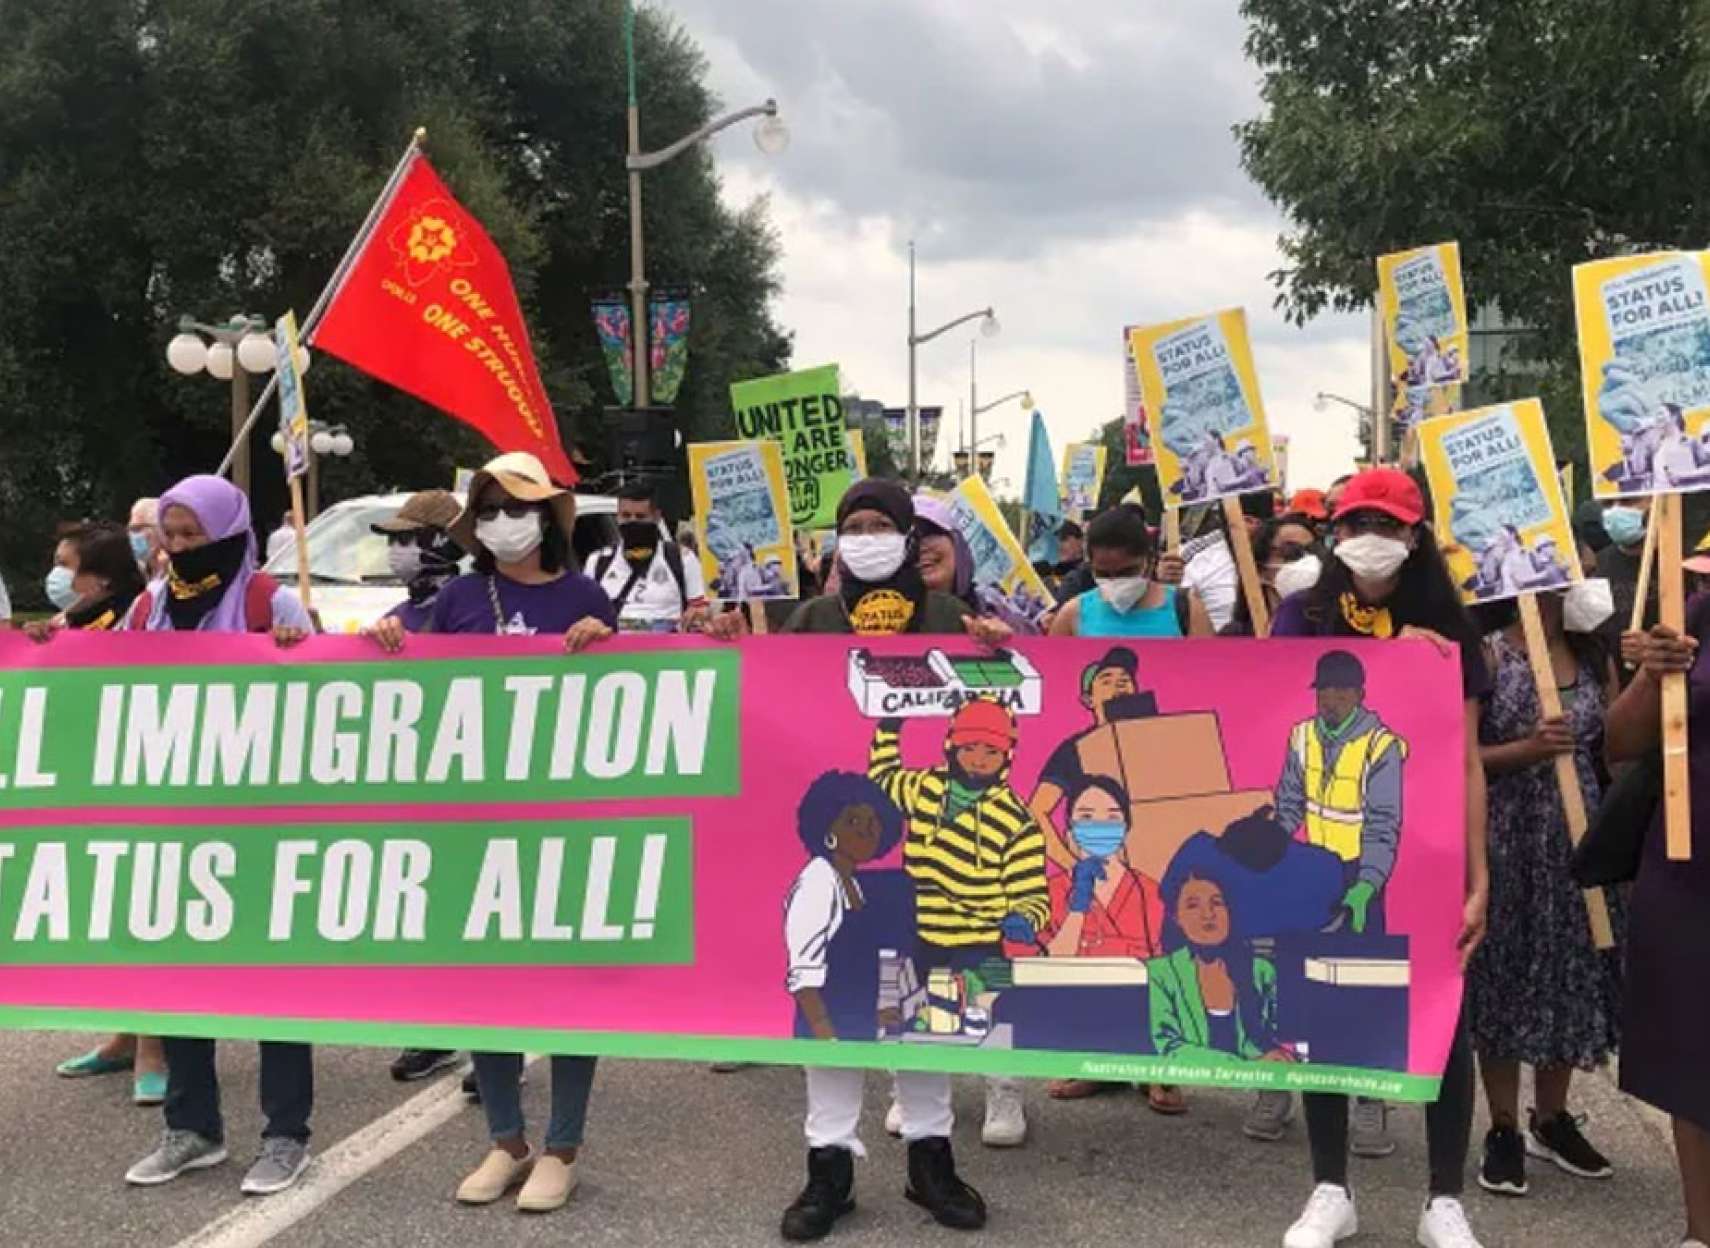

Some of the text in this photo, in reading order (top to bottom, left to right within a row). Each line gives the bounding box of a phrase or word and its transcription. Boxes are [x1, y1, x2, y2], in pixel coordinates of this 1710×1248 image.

[450, 278, 496, 321] ONE
[1606, 276, 1685, 310] STATUS
[1611, 290, 1703, 327] FOR ALL!
[423, 304, 471, 340] ONE
[1157, 333, 1211, 364] STATUS
[736, 393, 843, 439] UNITED
[793, 425, 842, 453] ARE
[1446, 425, 1504, 457] STATUS
[1451, 450, 1483, 470] FOR
[0, 669, 717, 789] L IMMIGRATION
[268, 838, 432, 942] FOR
[462, 833, 668, 941] ALL!
